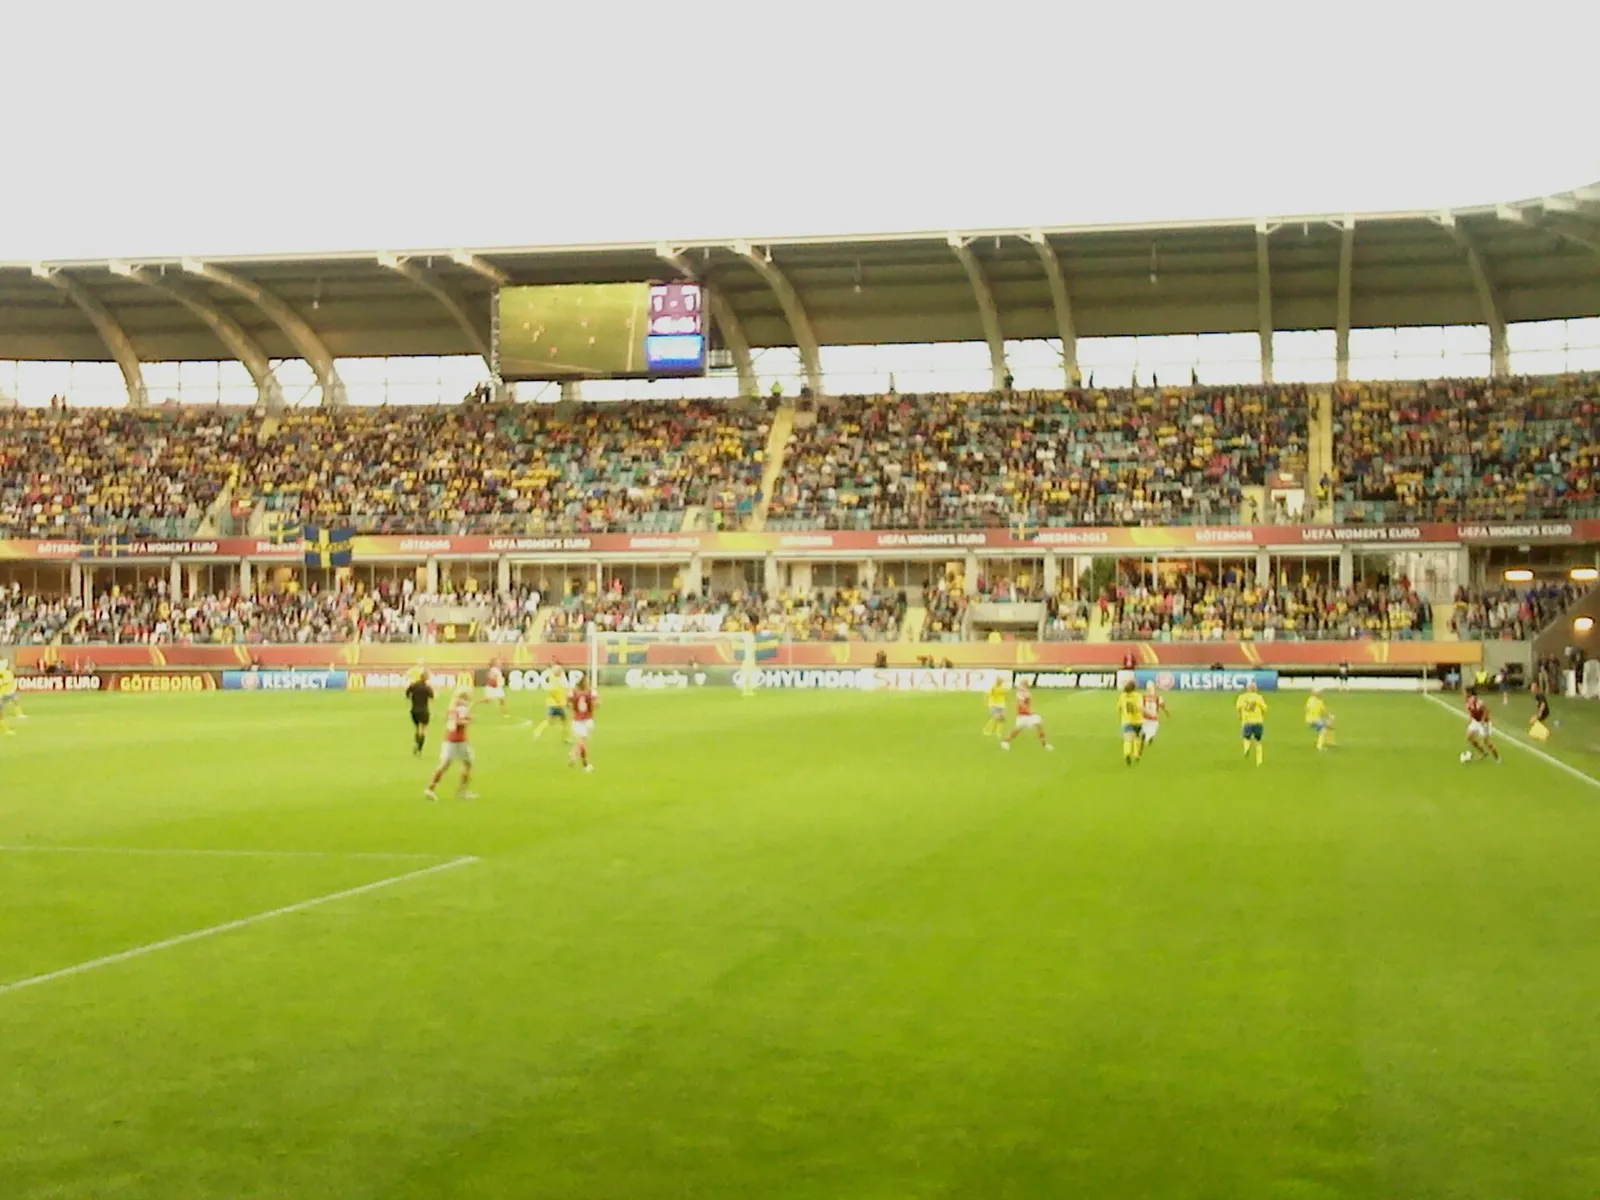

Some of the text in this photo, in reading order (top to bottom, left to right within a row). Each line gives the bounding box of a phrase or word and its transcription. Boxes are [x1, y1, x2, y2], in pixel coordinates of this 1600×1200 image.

[1302, 528, 1333, 539] UEFA
[1388, 527, 1420, 538] EURO
[1457, 526, 1488, 537] UEFA
[1541, 524, 1573, 535] EURO
[15, 675, 101, 690] OMEN'S EURO
[119, 673, 203, 691] GÖTEBORG
[261, 671, 329, 690] RESPECT
[873, 671, 984, 690] SHARP
[1179, 671, 1256, 690] RESPECT
